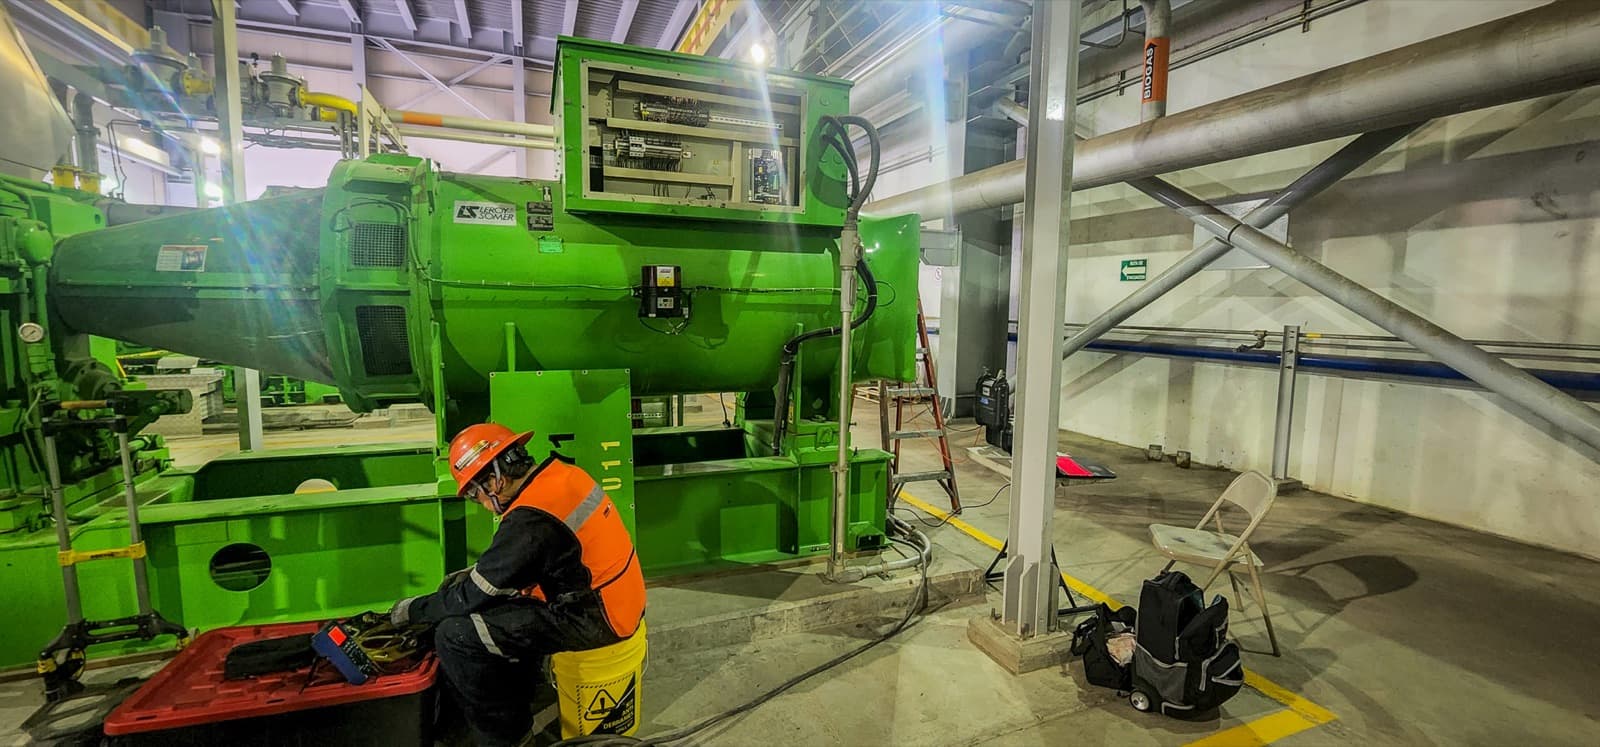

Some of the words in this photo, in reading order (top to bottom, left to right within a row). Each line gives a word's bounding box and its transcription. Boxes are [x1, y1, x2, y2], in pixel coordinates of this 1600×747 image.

[1143, 47, 1154, 99] BIOGAS
[478, 213, 515, 221] SOMER
[480, 206, 509, 214] LEROY
[601, 441, 622, 490] U11
